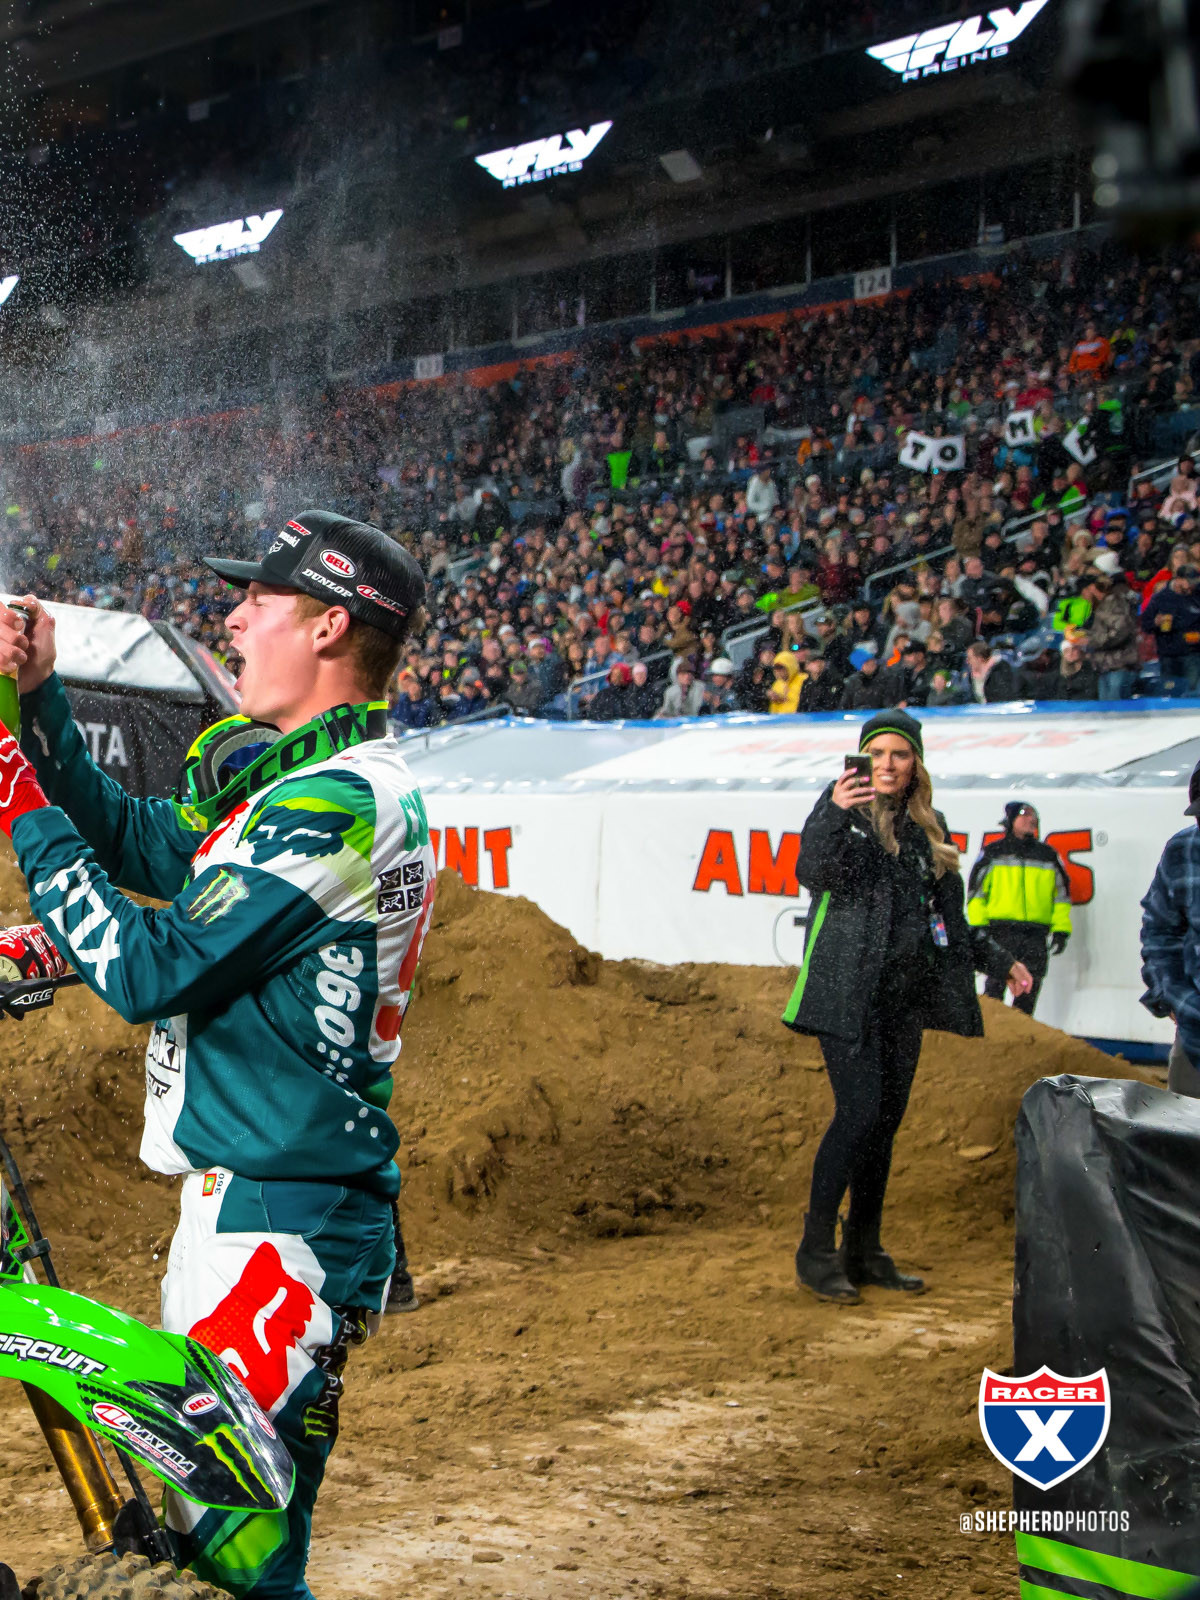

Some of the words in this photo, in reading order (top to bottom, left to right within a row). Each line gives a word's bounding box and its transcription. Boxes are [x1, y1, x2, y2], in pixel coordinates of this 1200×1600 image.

[885, 0, 1049, 72] FLY
[902, 44, 1010, 83] RACING
[325, 553, 351, 575] BELL
[302, 568, 354, 598] DUNLOP
[9, 988, 54, 1006] ARC
[316, 941, 365, 1048] 360
[214, 1172, 225, 1195] 360
[187, 1396, 217, 1413] BELL
